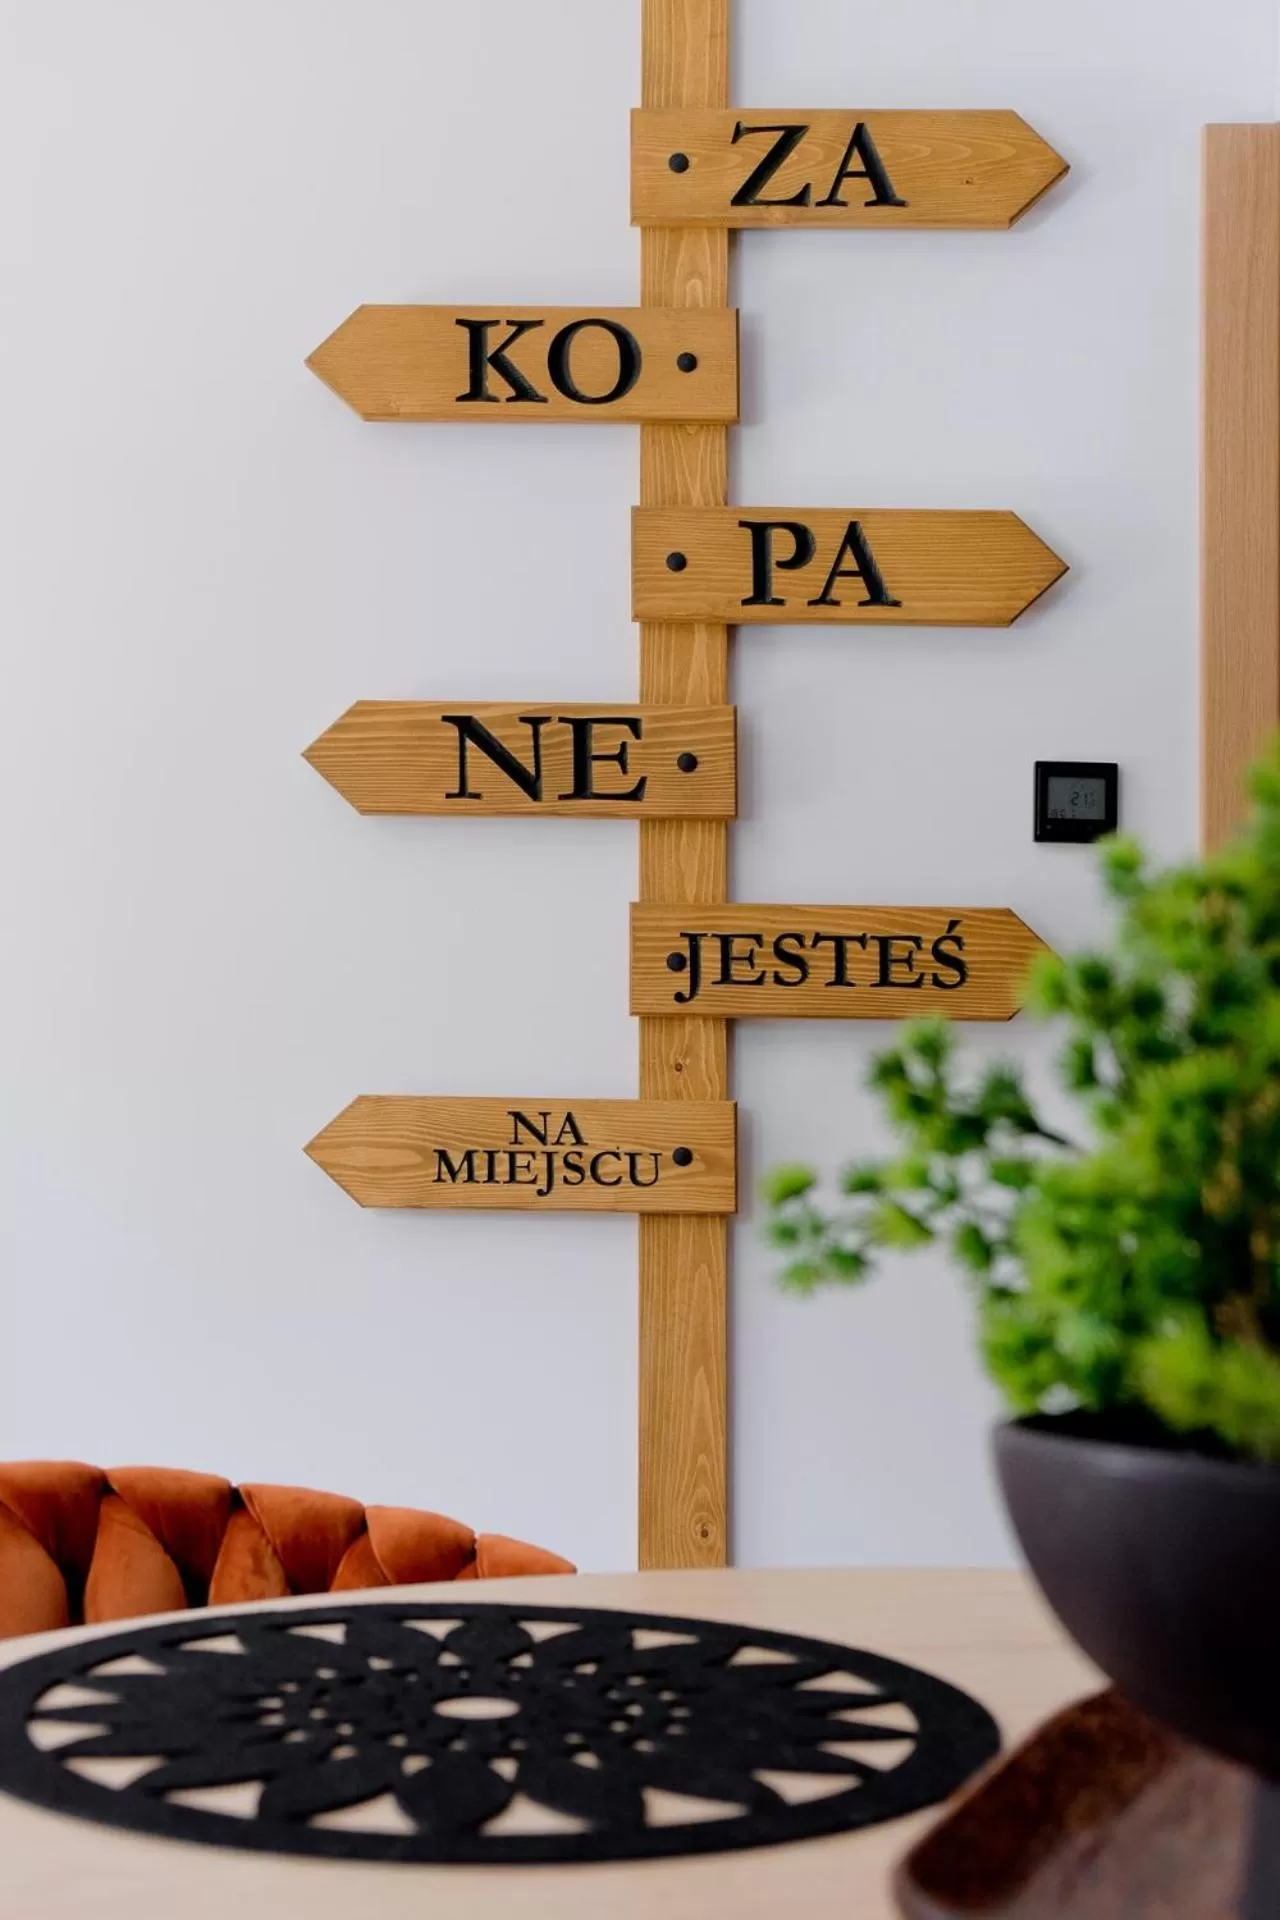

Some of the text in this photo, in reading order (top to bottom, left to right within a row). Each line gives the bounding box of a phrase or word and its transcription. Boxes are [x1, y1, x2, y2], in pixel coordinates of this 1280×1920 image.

[731, 121, 907, 208] ZA
[456, 319, 641, 404] KO
[738, 521, 902, 607] PA
[442, 716, 647, 801] NE
[674, 919, 970, 1004] JESTEŚ
[508, 1111, 589, 1146] NA
[433, 1149, 661, 1197] MIEJSCU
